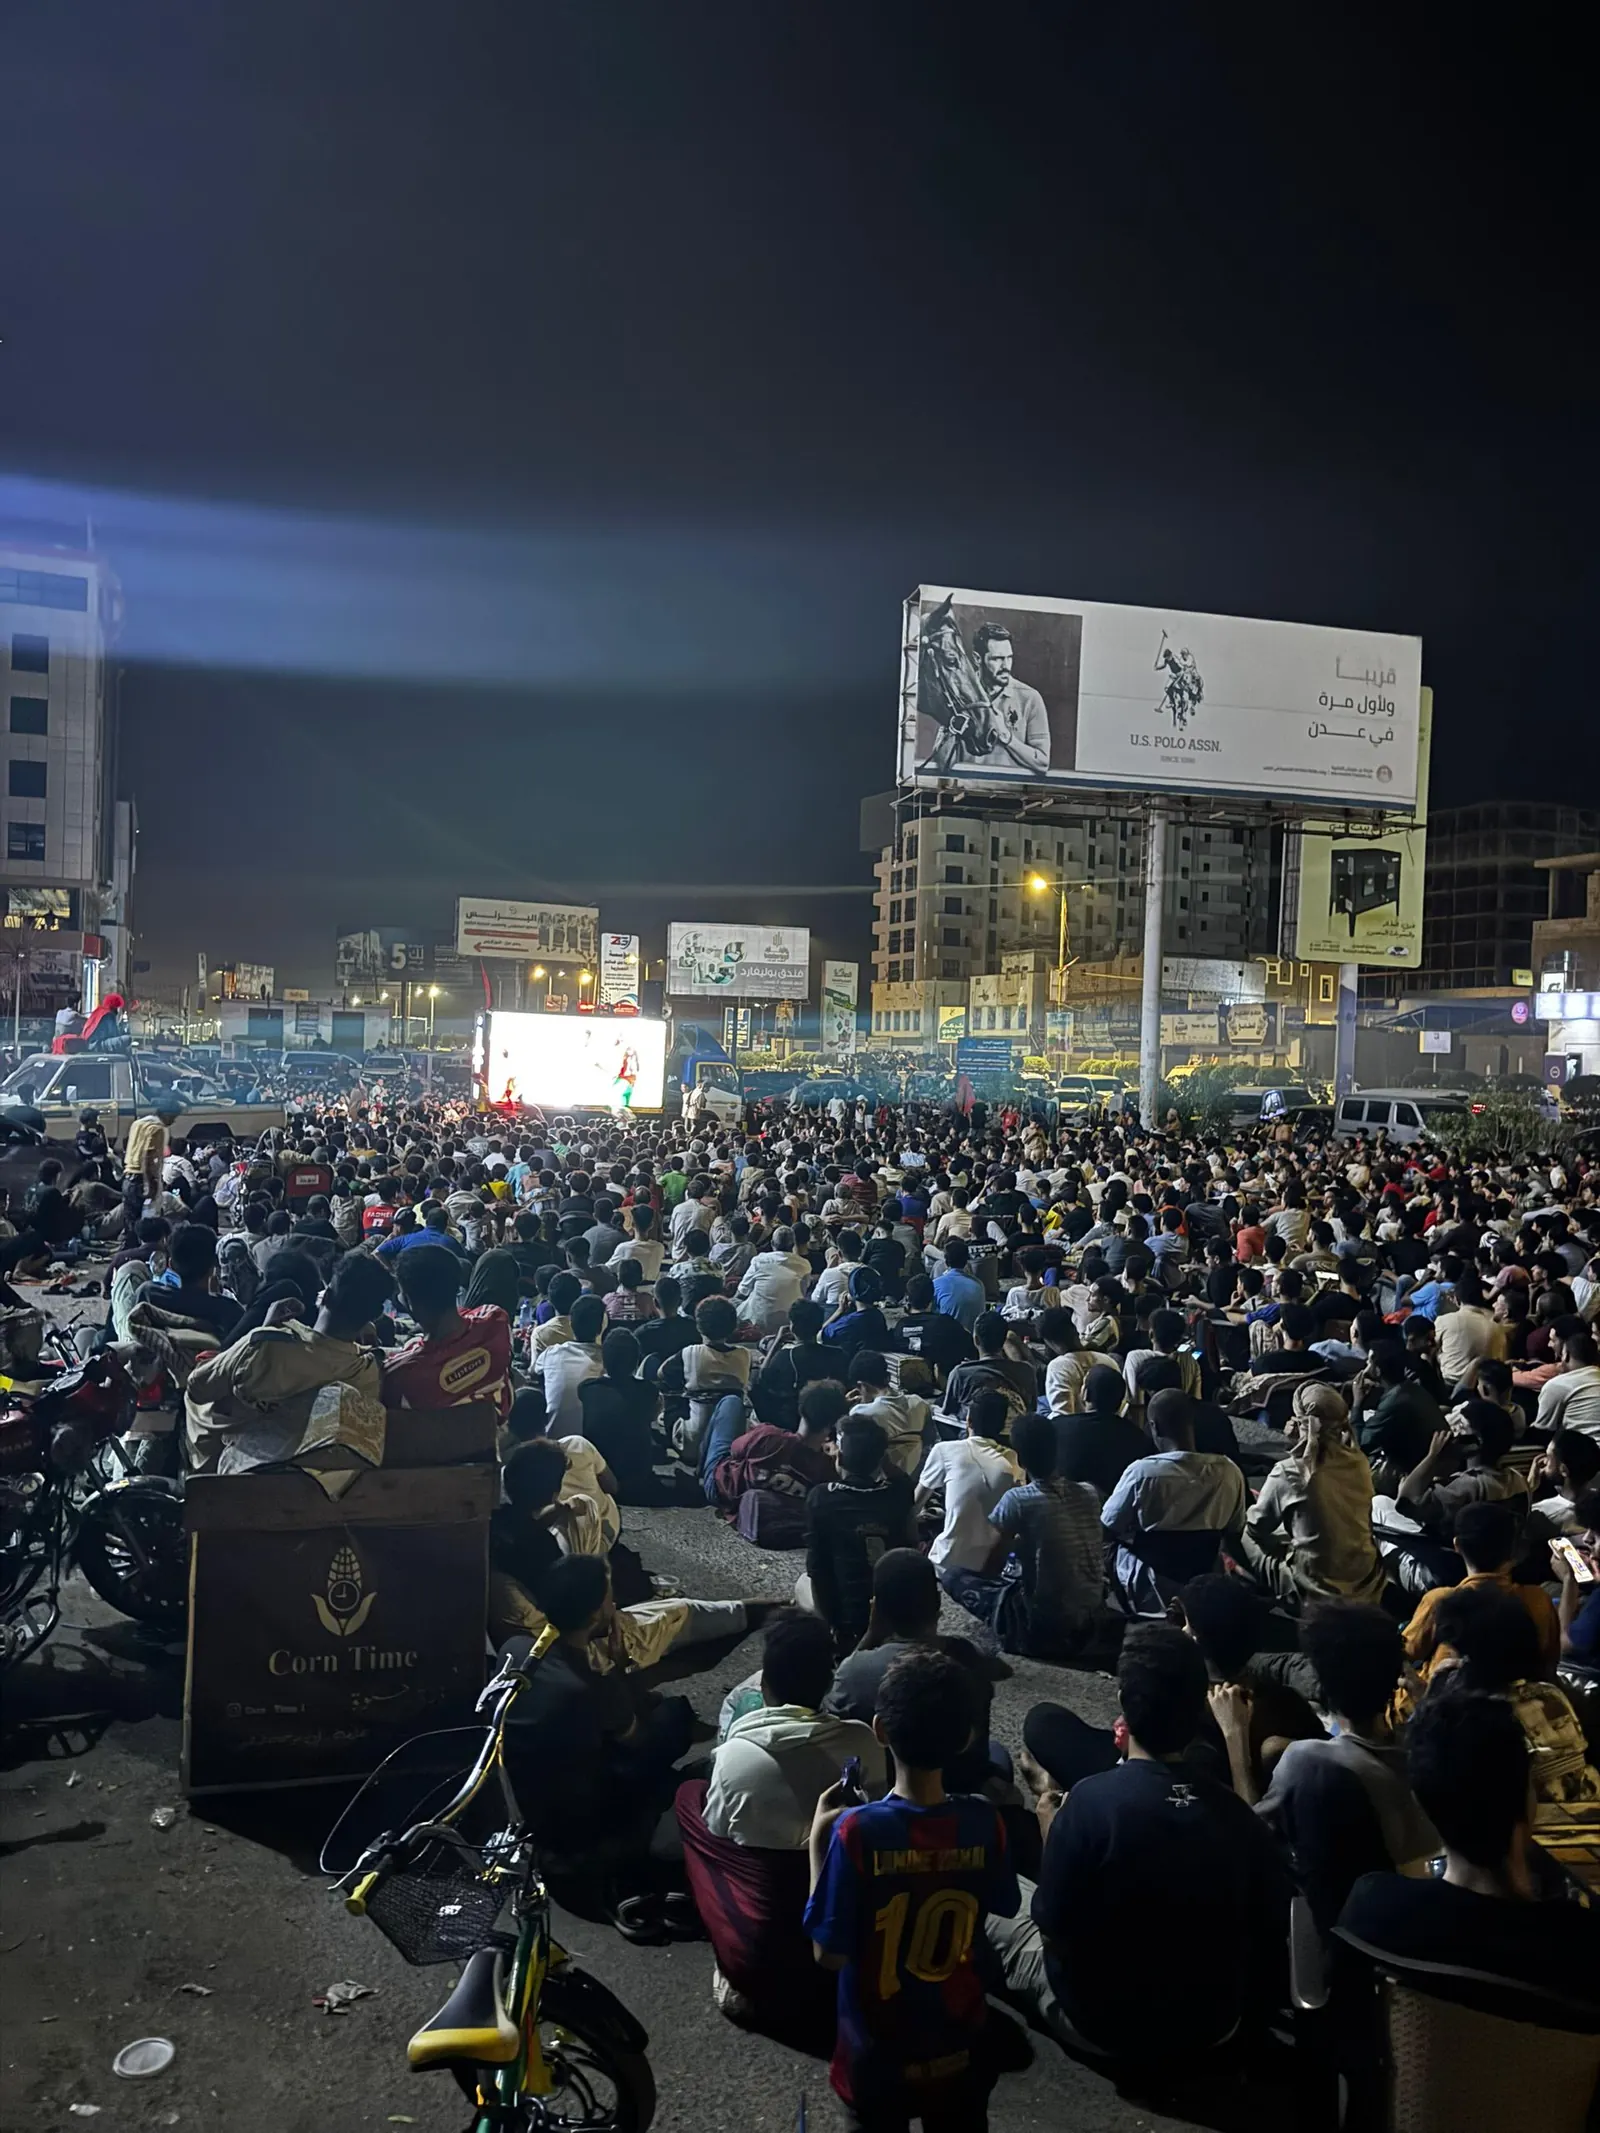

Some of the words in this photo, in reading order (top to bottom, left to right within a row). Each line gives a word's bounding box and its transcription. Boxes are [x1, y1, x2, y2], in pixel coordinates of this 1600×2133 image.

[1318, 691, 1354, 711] مرة
[1357, 694, 1395, 717] ولأول
[1308, 721, 1366, 739] عدن
[1369, 727, 1394, 748] في
[1130, 734, 1152, 747] U.S.
[1154, 736, 1186, 749] POLO
[1188, 739, 1222, 752] ASSN.
[390, 943, 406, 970] 5
[777, 967, 804, 979] فندق
[447, 1358, 483, 1383] Lipton
[268, 1648, 339, 1676] Corn
[347, 1645, 418, 1672] Time
[874, 1887, 980, 2001] 10
